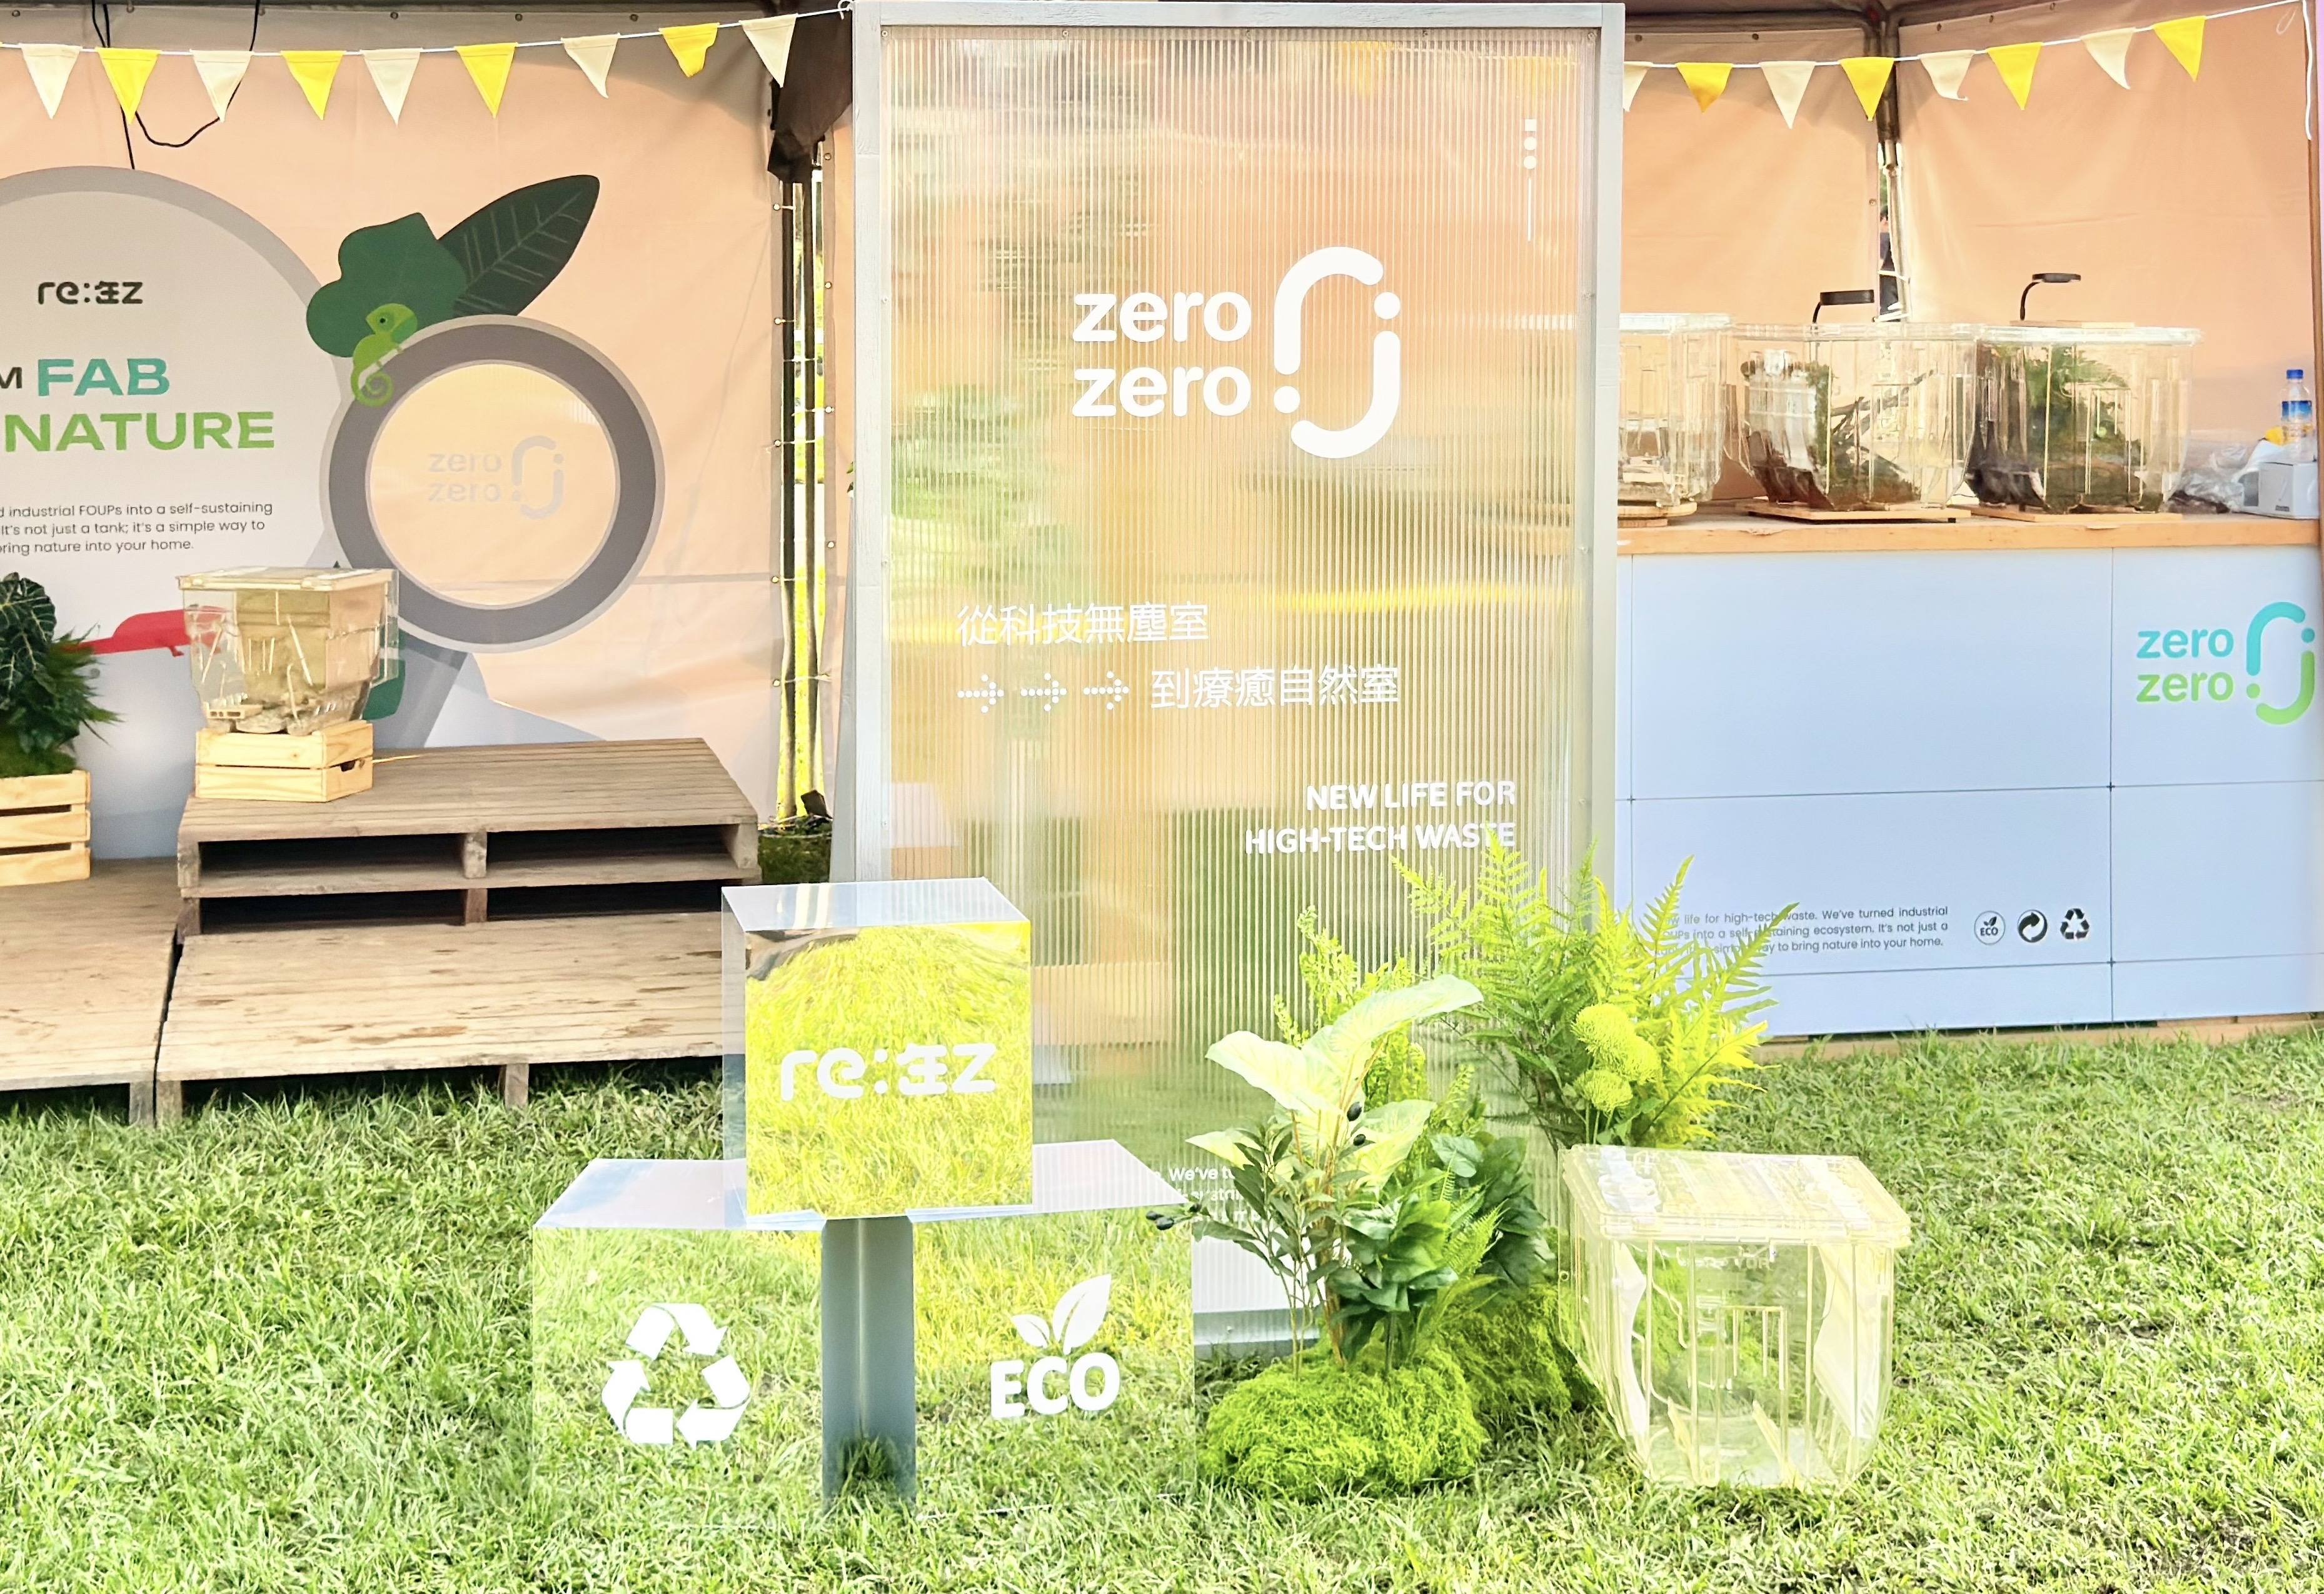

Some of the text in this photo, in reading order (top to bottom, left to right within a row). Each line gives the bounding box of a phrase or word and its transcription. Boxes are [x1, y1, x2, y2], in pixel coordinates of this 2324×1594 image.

[1072, 291, 1251, 343] zero
[38, 358, 169, 396] FAB
[1072, 366, 1250, 416] zero
[5, 411, 274, 452] NATURE
[429, 453, 501, 472] zero
[428, 484, 500, 502] zero
[9, 506, 74, 518] industrial
[79, 504, 122, 516] FOUPs
[126, 504, 153, 515] into
[157, 506, 166, 515] a
[170, 502, 273, 516] self-sustaining
[1, 521, 264, 536] It's not just a tank; it's a simple way to
[34, 541, 81, 553] nature
[85, 540, 112, 551] into
[116, 541, 146, 553] your
[151, 539, 194, 551] home.
[957, 602, 1209, 646] 從科技無塵室
[2136, 628, 2234, 658] zero
[1150, 665, 1399, 709] 到療癒自然室
[2136, 672, 2234, 702] zero
[1307, 780, 1516, 810] NEW LIFE FOR
[1245, 823, 1516, 855] HIGH-TECH WASTE
[1684, 914, 1700, 924] life
[1705, 913, 1719, 923] for
[1822, 910, 1854, 920] We've
[1859, 908, 1894, 918] turned
[1899, 906, 1948, 918] industrial
[1718, 930, 1726, 939] a
[1813, 924, 1874, 936] ecosystem.
[1878, 923, 1893, 933] It's
[1897, 923, 1914, 932] not
[1917, 921, 1937, 933] just
[1941, 922, 1948, 931] a
[1778, 941, 1789, 951] to
[1791, 941, 1819, 953] bring
[1823, 940, 1858, 950] nature
[1861, 938, 1881, 948] into
[1884, 938, 1907, 950] your
[1910, 937, 1943, 947] home.
[1980, 927, 1998, 936] ECO
[1169, 1167, 1218, 1181] We've
[990, 1352, 1120, 1419] ECO
